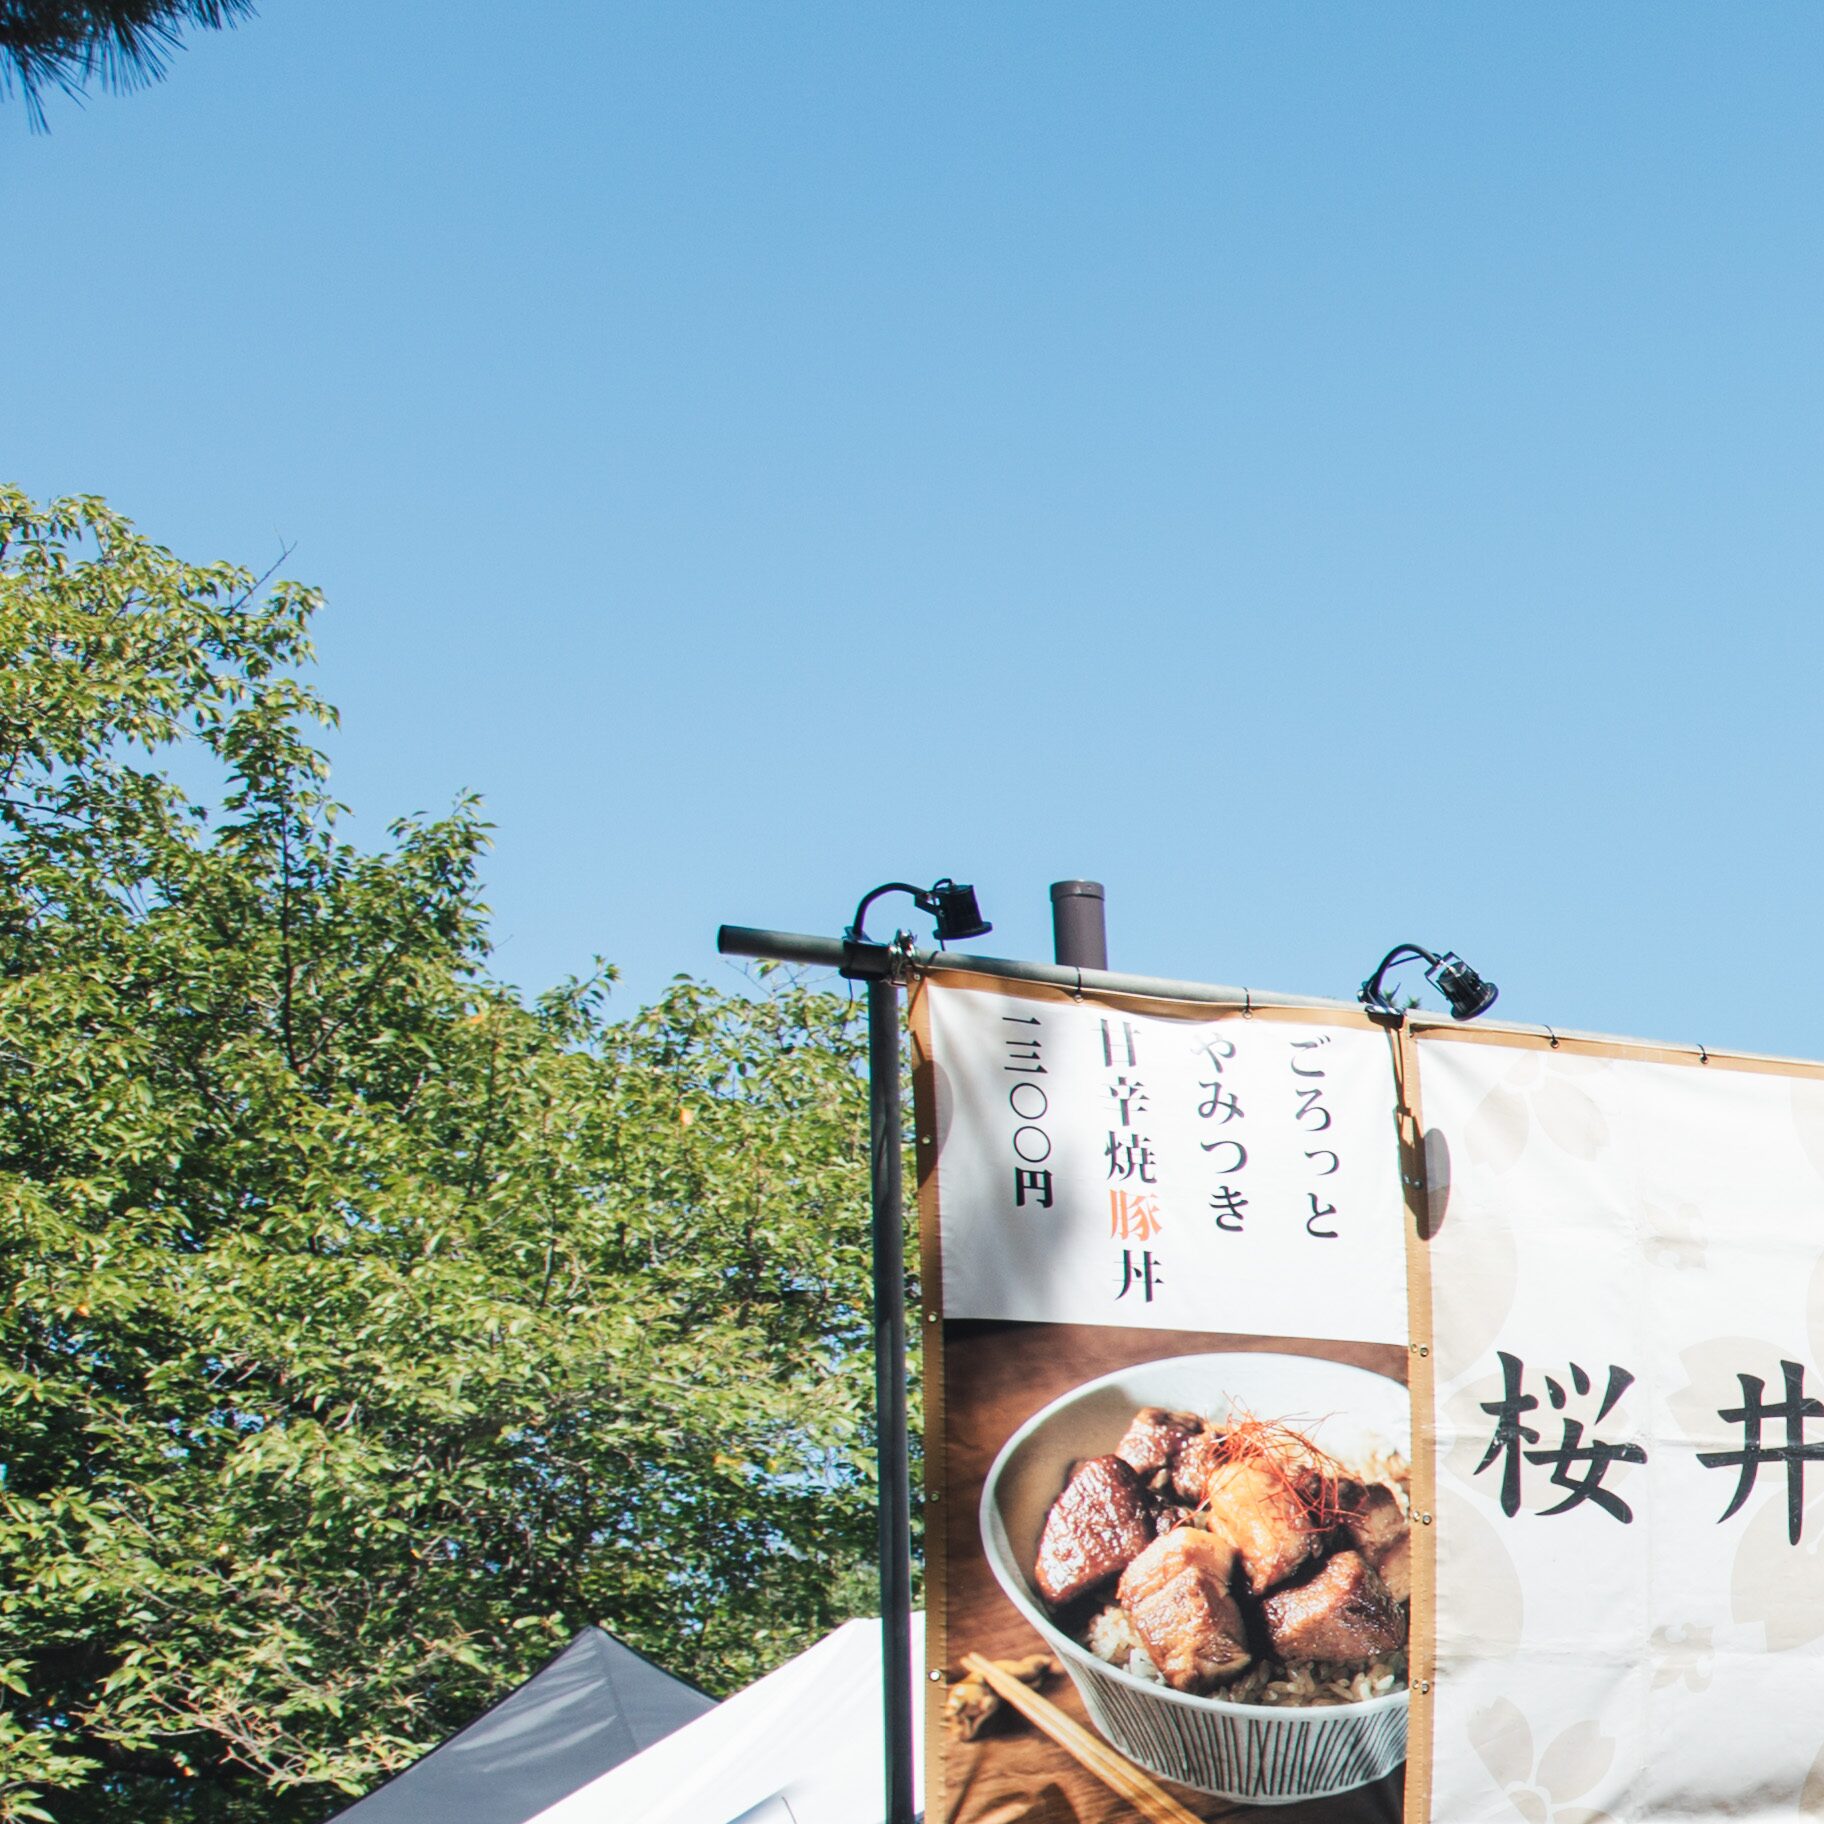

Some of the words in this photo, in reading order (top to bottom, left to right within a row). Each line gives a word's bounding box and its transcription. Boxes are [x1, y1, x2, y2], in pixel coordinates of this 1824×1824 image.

[1092, 1018, 1166, 1304] 甘辛焼豚丼
[1190, 1031, 1249, 1234] やみつき
[1289, 1034, 1341, 1240] ごろっと
